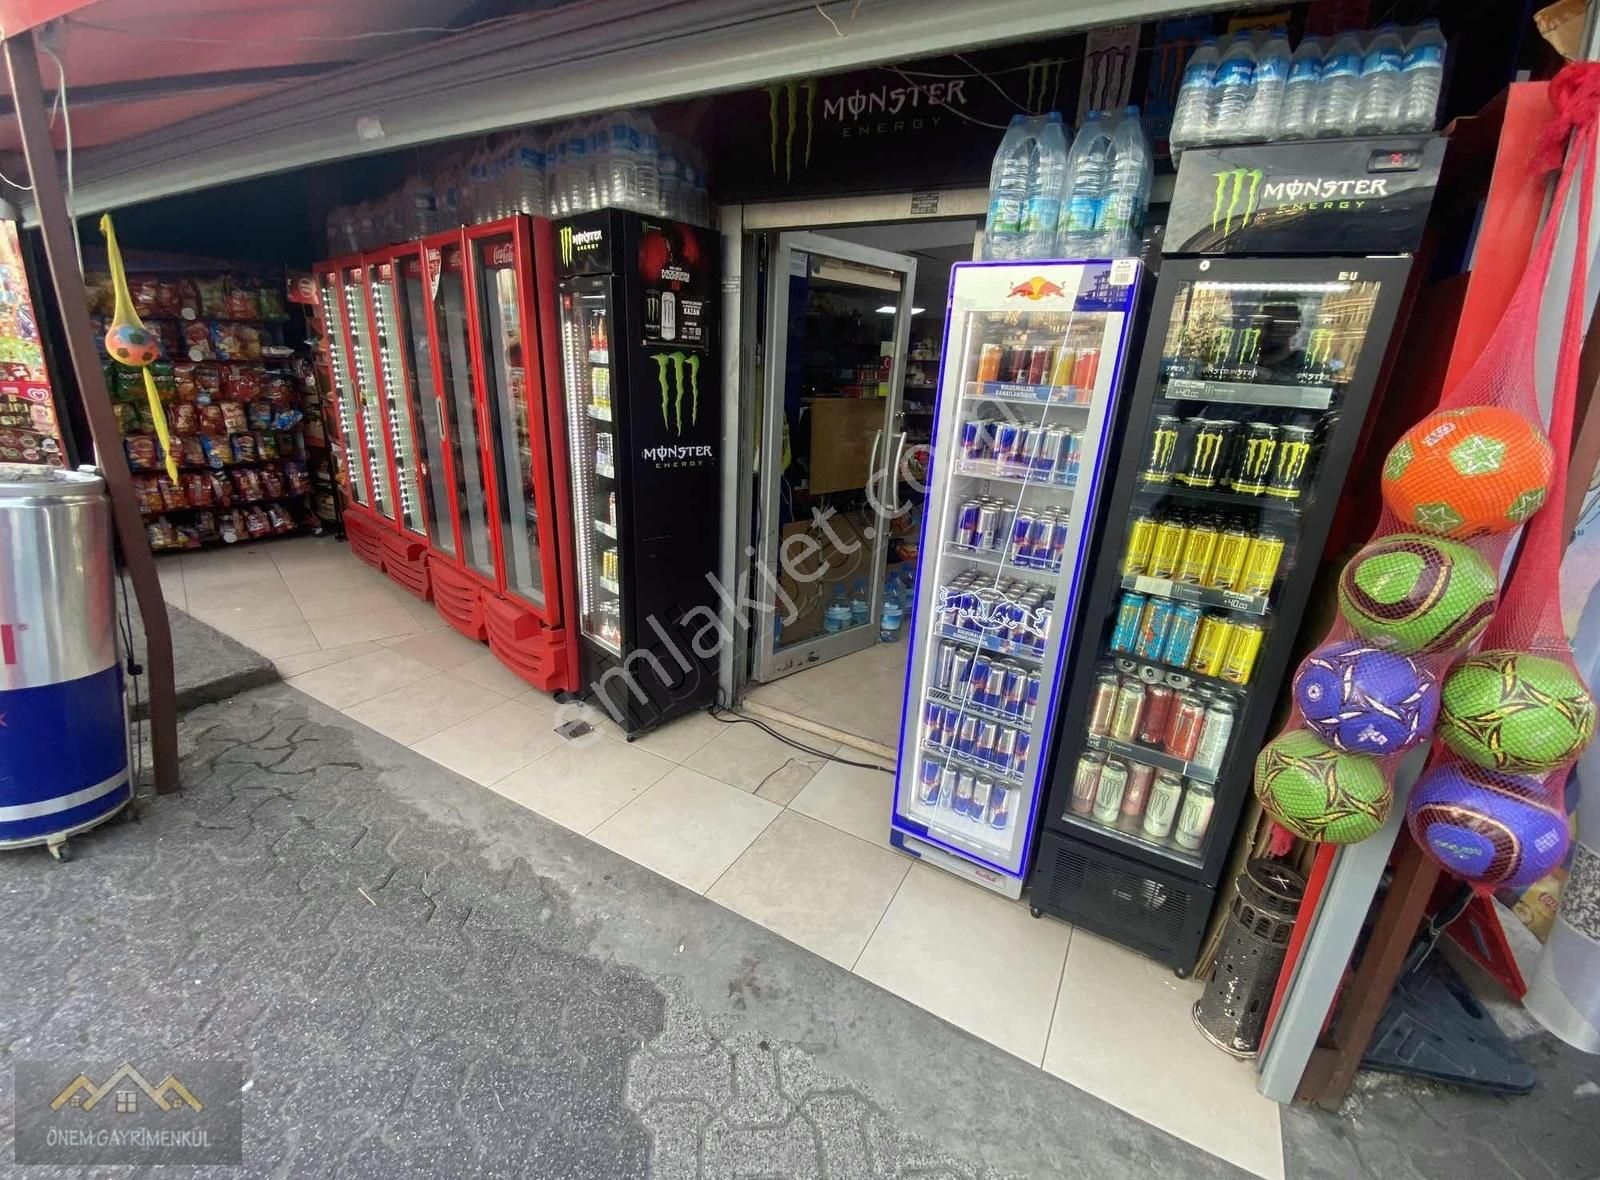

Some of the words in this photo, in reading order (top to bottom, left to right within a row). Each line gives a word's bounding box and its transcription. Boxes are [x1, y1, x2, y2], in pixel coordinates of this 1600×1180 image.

[841, 116, 942, 138] ENERGY
[1278, 200, 1366, 211] ENERGY
[577, 243, 599, 251] ENERGY
[655, 460, 703, 469] ENERGY
